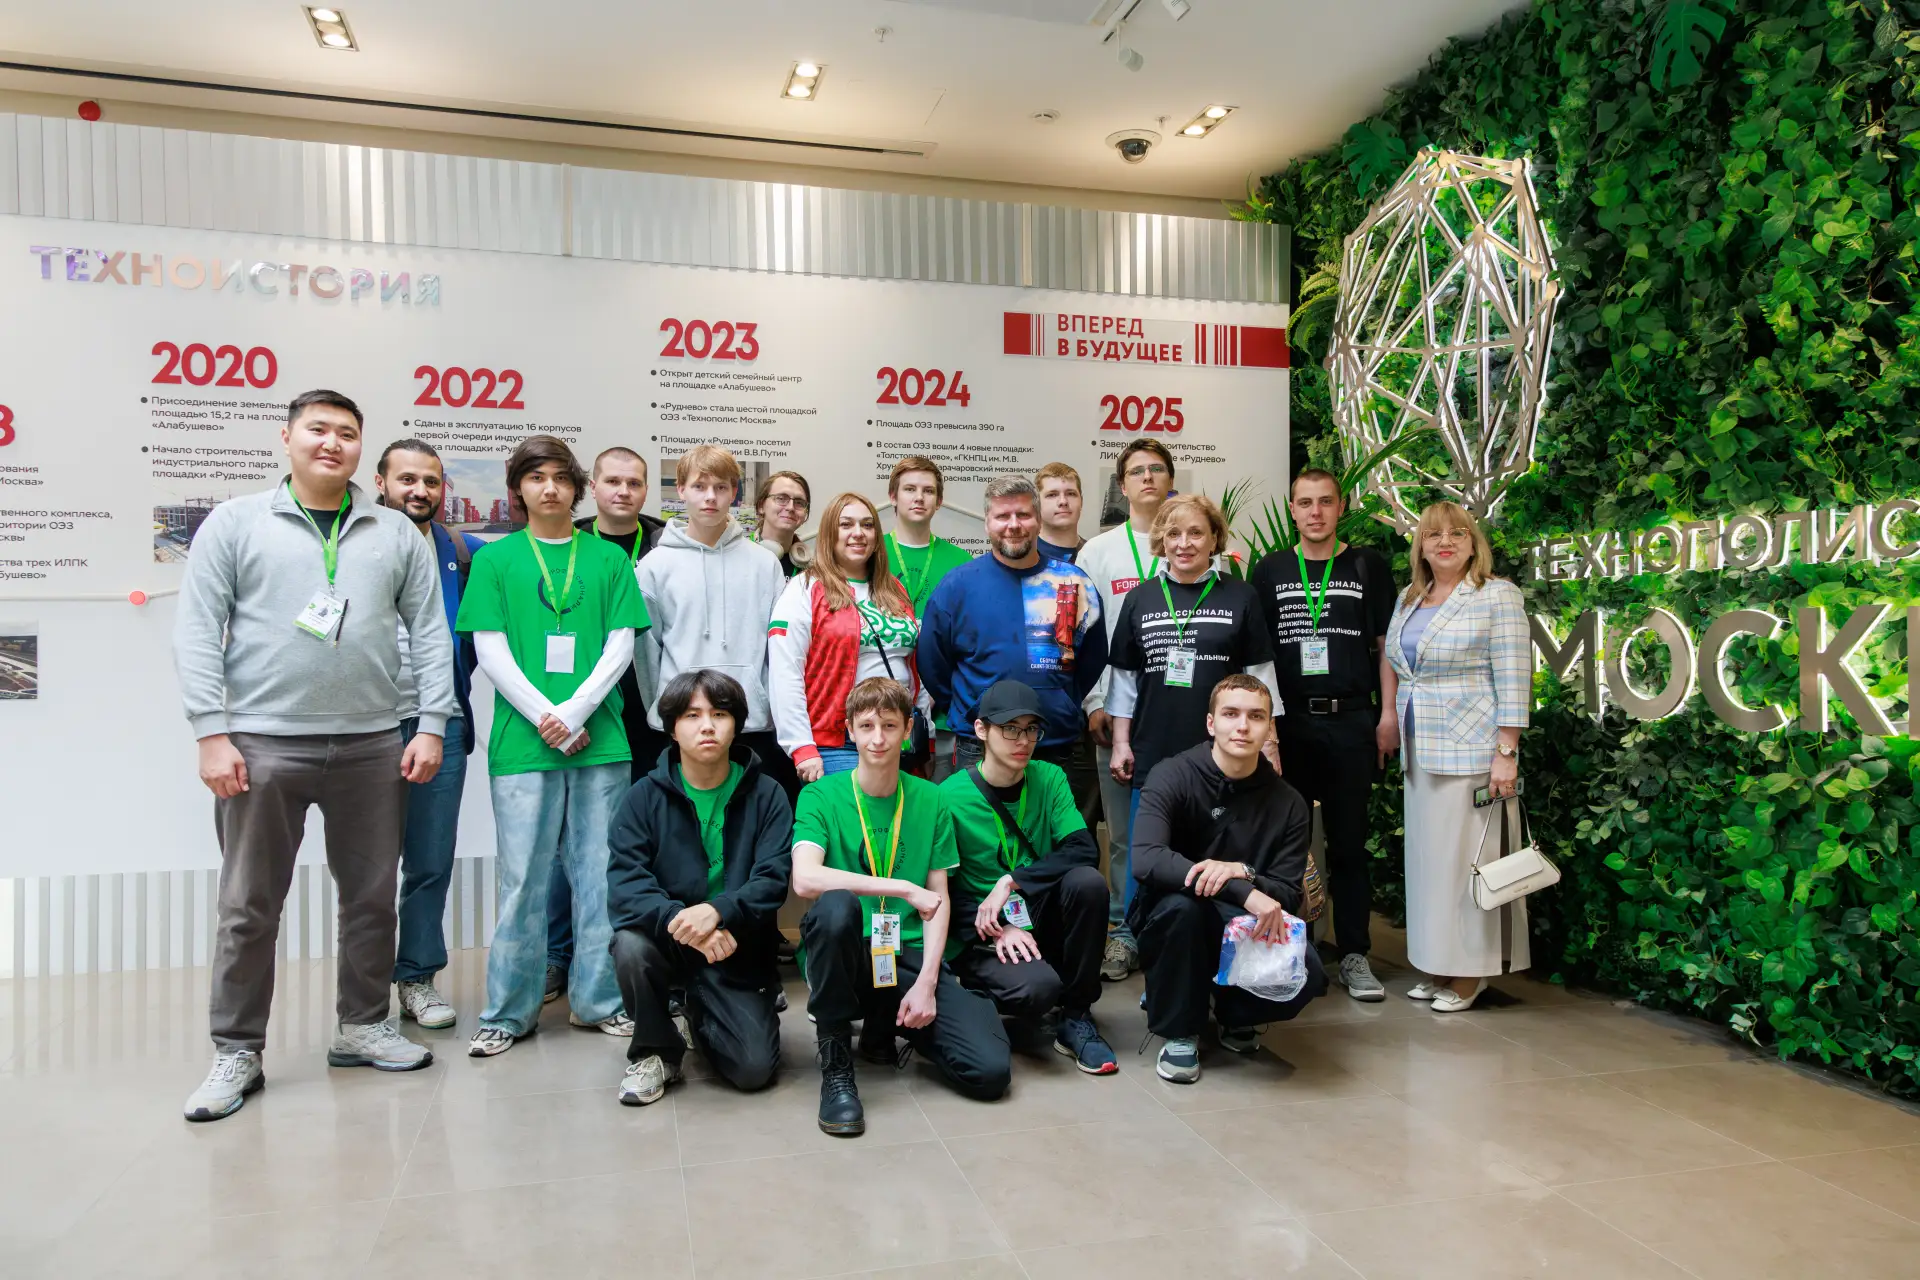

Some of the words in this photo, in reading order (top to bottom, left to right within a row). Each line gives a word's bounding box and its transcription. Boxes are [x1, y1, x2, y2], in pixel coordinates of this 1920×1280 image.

[30, 246, 440, 305] ТЕХНОИСТОРИЯ
[1058, 314, 1144, 338] ВПЕРЕД
[660, 318, 759, 360] 2023
[1058, 339, 1069, 356] В
[1077, 340, 1182, 362] БУДУЩЕЕ
[152, 341, 278, 388] 2020
[660, 370, 693, 380] Открыт
[695, 371, 730, 380] детский
[733, 373, 775, 382] семейный
[777, 375, 802, 384] центр
[414, 365, 524, 410] 2022
[673, 382, 716, 391] площадке
[718, 384, 776, 393] «Алабушево»
[876, 367, 970, 407] 2024
[152, 397, 238, 408] Присоединение
[661, 403, 708, 412] «Руднево»
[737, 406, 768, 414] шестой
[769, 407, 817, 416] площадкой
[1100, 395, 1184, 432] 2025
[152, 410, 208, 420] площадью
[210, 411, 232, 420] 15,2
[234, 414, 245, 422] га
[660, 413, 680, 421] ОЭЗ
[682, 414, 738, 424] «Технополис
[740, 417, 777, 425] Москва»
[152, 421, 225, 432] «Алабушево»
[414, 419, 446, 429] Сданы
[456, 422, 524, 433] эксплуатацию
[539, 425, 582, 435] корпусов
[876, 419, 913, 430] Площадь
[914, 421, 932, 429] ОЭЗ
[934, 423, 977, 433] превысила
[414, 431, 450, 440] первой
[452, 433, 493, 443] очереди
[660, 435, 706, 445] Площадку
[152, 445, 193, 454] Начало
[195, 448, 273, 457] строительства
[445, 444, 493, 454] площадки
[744, 449, 787, 459] В.В.Путин
[913, 442, 931, 450] ОЭЗ
[960, 443, 965, 451] 4
[993, 446, 1034, 455] площадки:
[152, 458, 247, 468] индустриального
[249, 461, 279, 470] парка
[954, 454, 987, 463] «ГКНПЦ
[1003, 456, 1019, 464] М.В.
[1180, 455, 1226, 465] «Руднево»
[152, 470, 207, 480] площадки
[209, 471, 267, 482] «Руднево»
[51, 510, 113, 520] комплекса,
[49, 521, 74, 530] ОЭЗ
[1522, 499, 1920, 581] ТЕХНОПОЛИС
[26, 560, 52, 569] трех
[54, 559, 88, 568] ИЛПК
